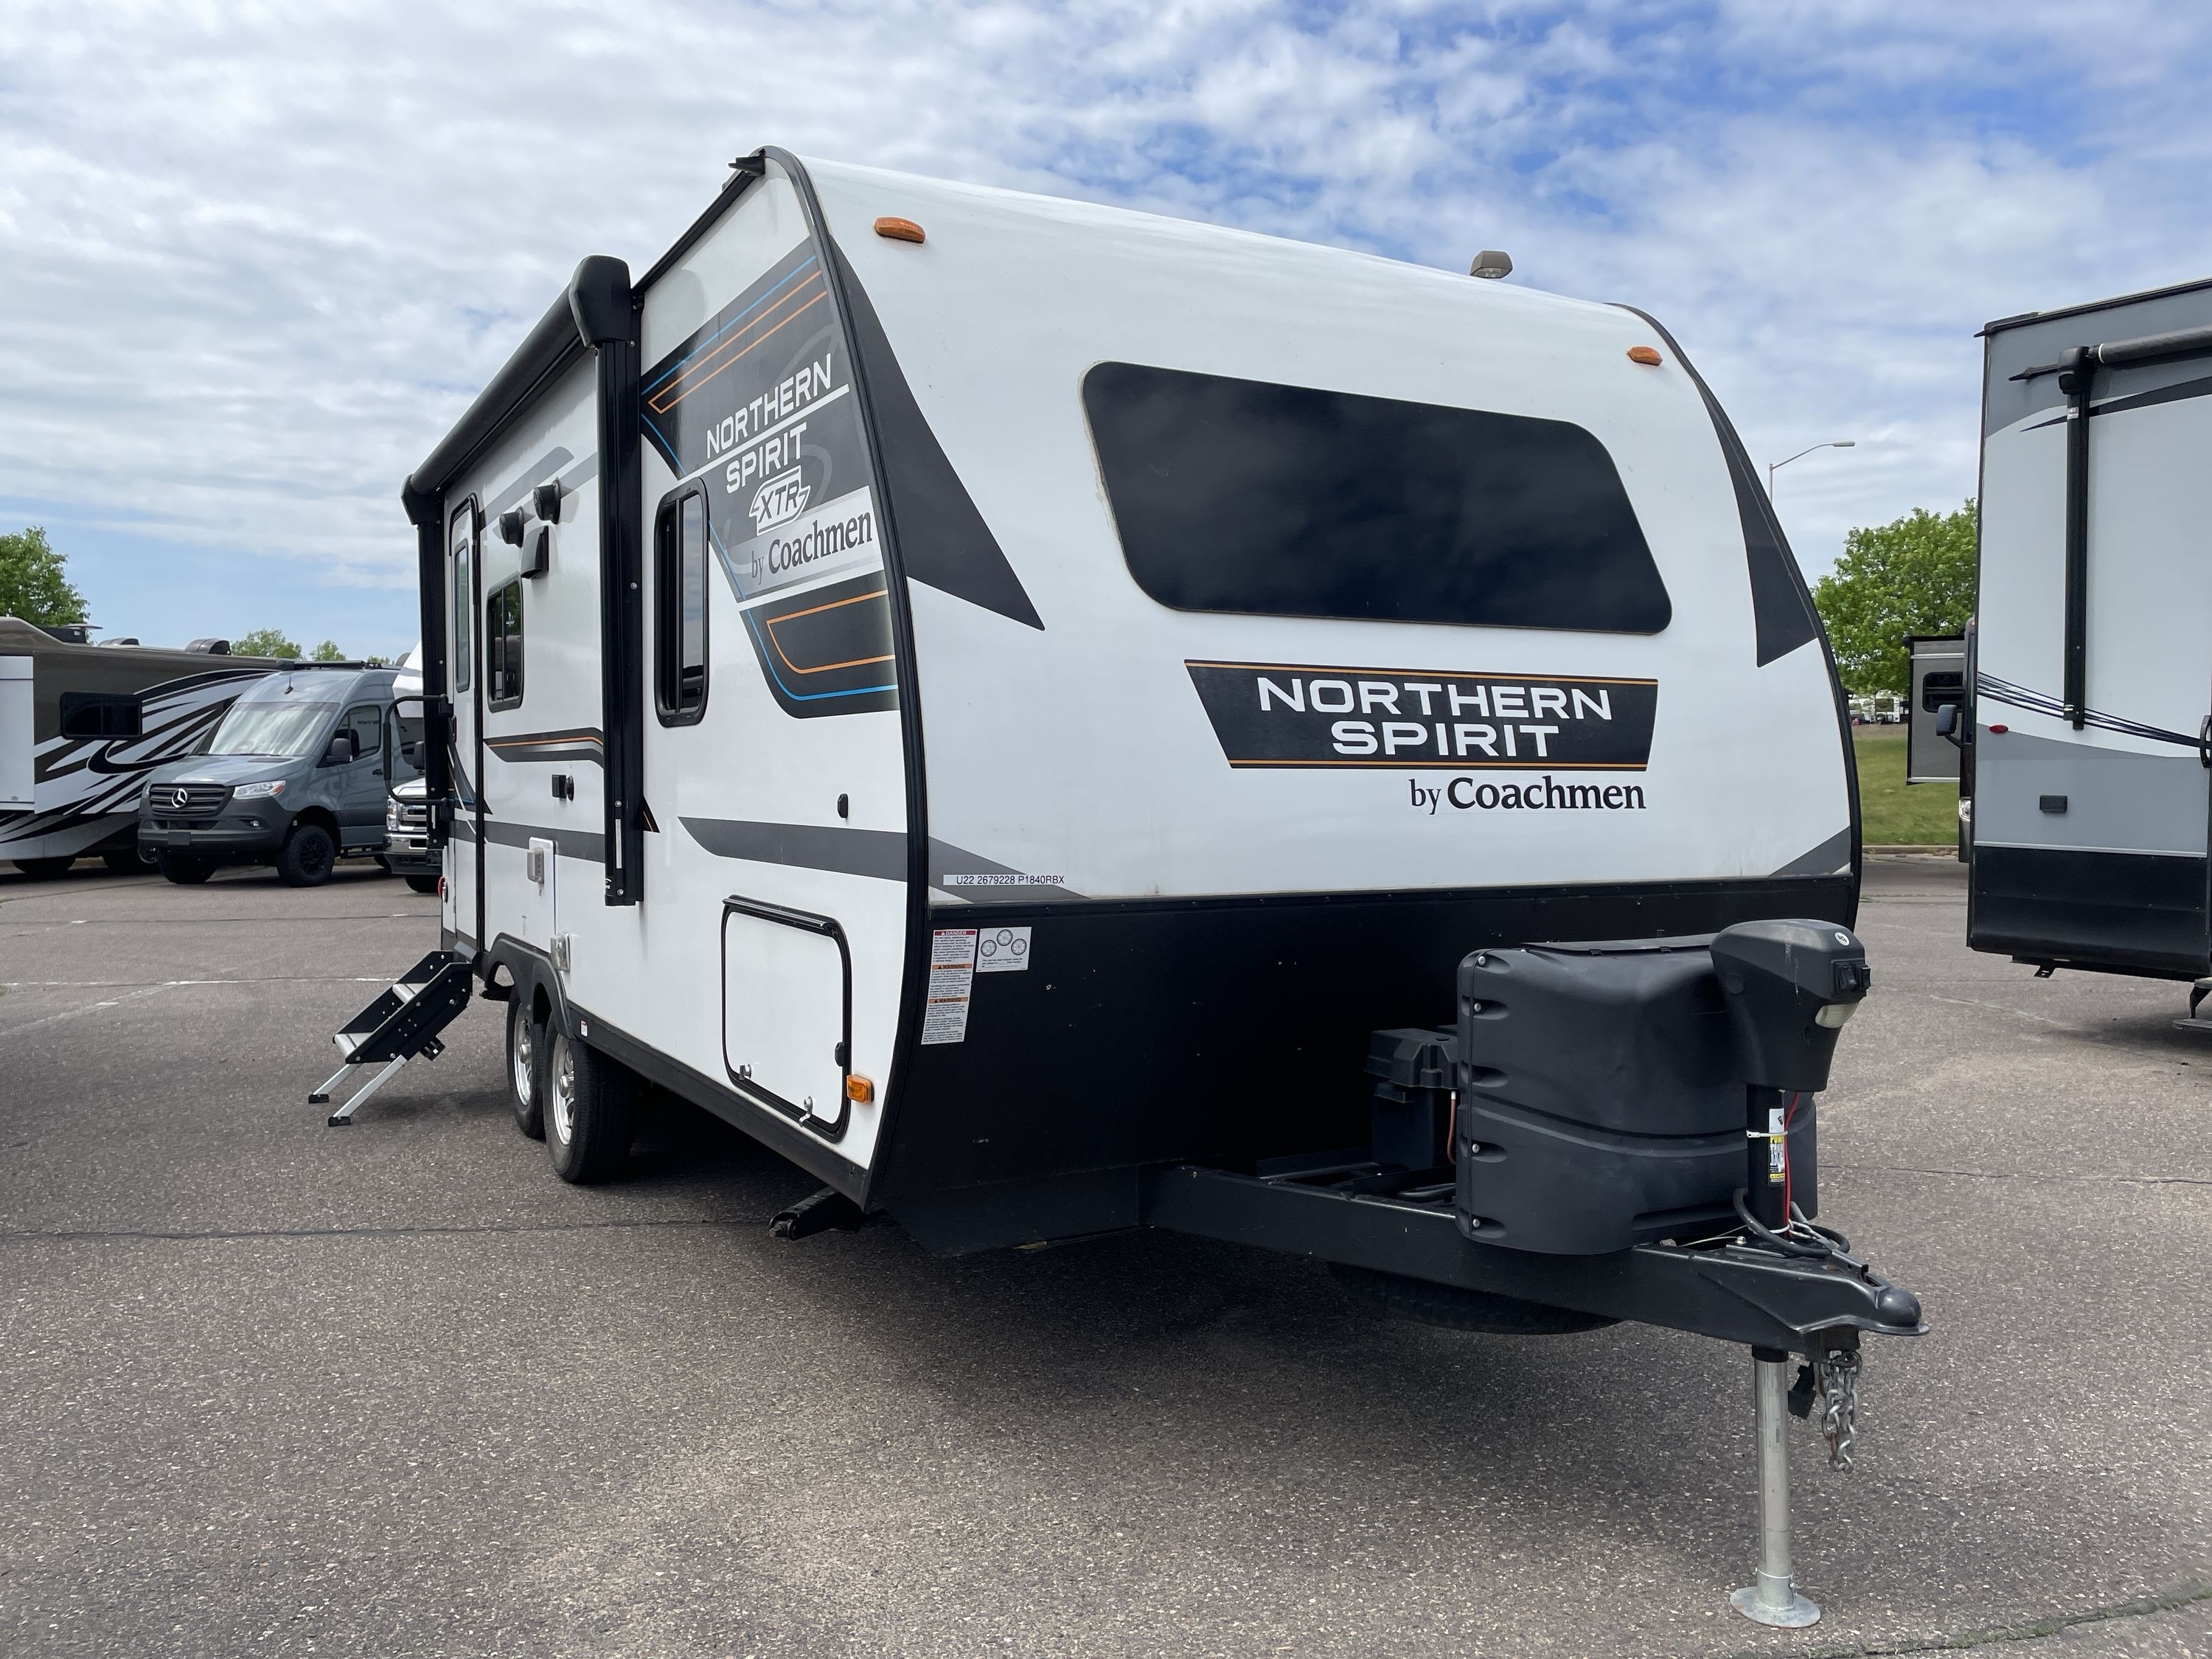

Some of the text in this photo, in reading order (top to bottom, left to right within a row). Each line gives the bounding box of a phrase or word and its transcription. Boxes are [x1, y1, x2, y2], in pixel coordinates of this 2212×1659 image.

[706, 353, 831, 459] NORTHERN
[726, 422, 807, 494] SPIRIT
[758, 479, 799, 524] XTR
[751, 512, 872, 585] by Coachmen
[1256, 677, 1613, 720] NORTHERN
[1330, 720, 1559, 757] SPIRIT
[1409, 775, 1646, 815] by Coachmen
[956, 875, 1065, 884] U22 2679228 P1840RBX
